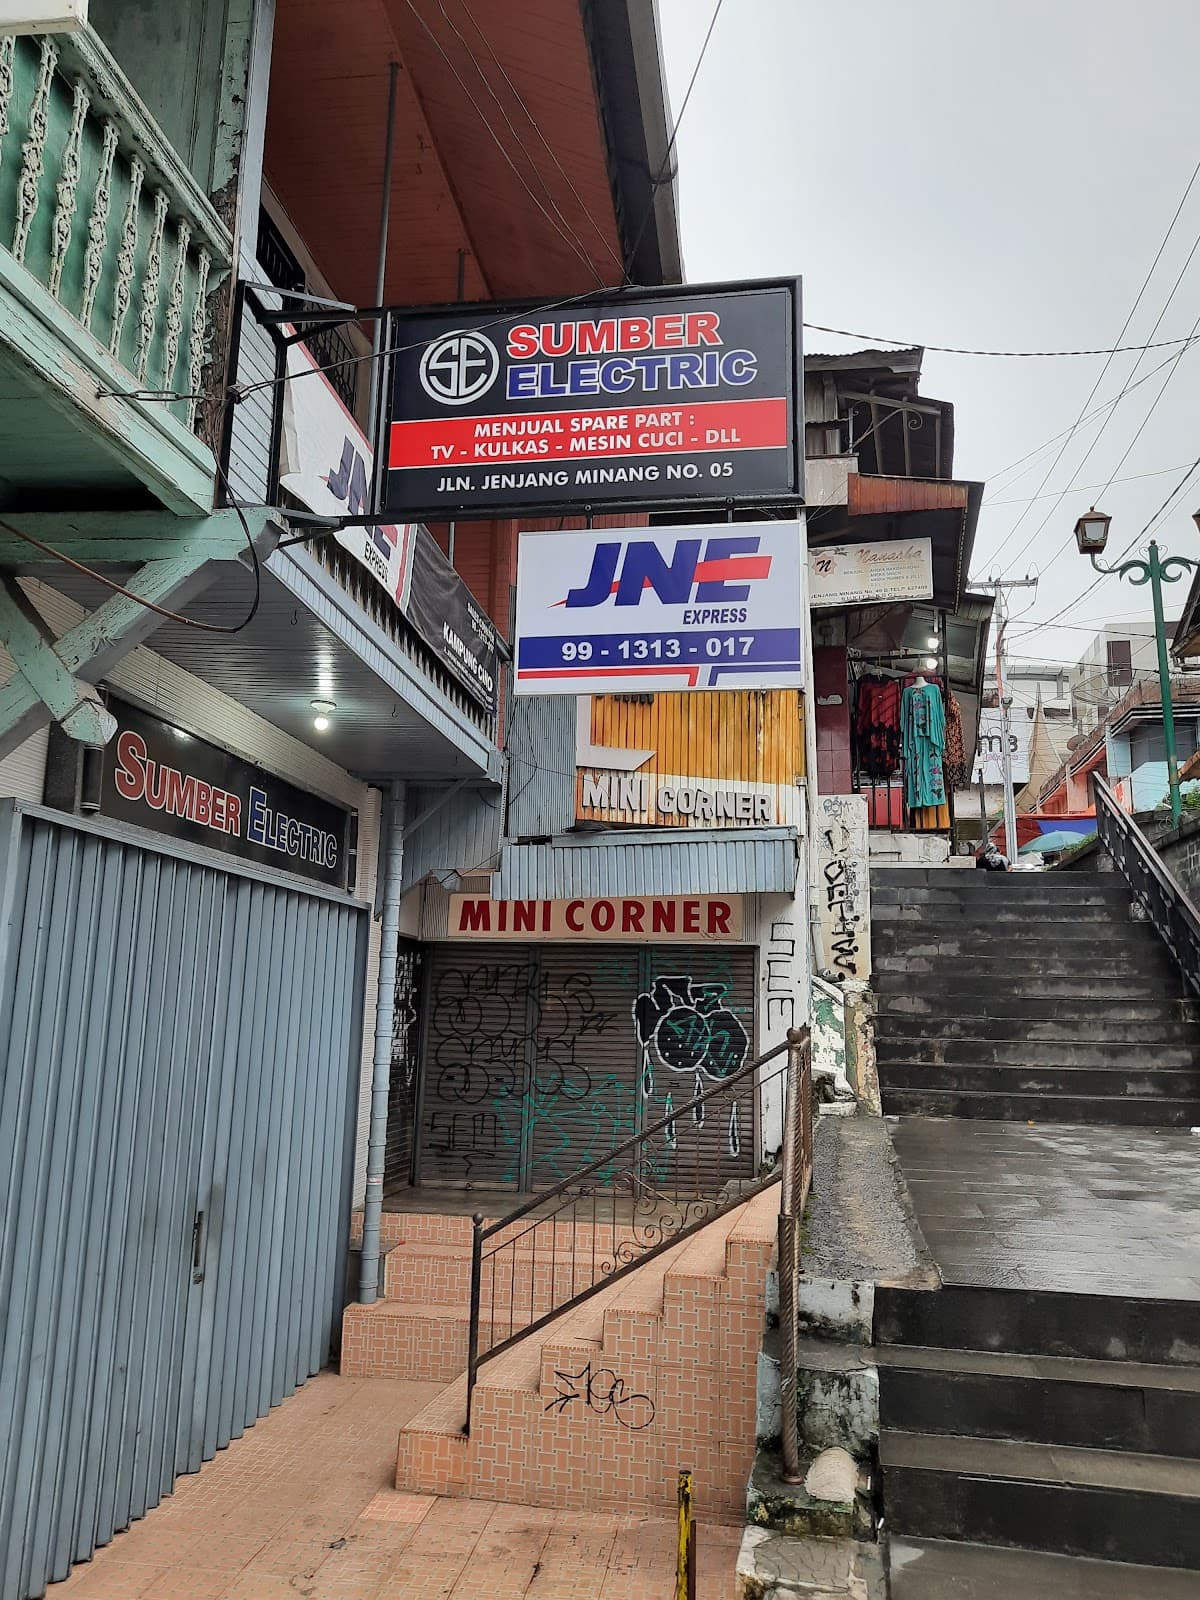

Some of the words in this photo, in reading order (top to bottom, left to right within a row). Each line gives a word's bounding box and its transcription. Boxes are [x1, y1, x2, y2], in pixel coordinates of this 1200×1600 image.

[506, 311, 724, 359] SUMBER
[505, 349, 758, 400] ELECTRIC
[431, 445, 454, 460] TV
[474, 439, 549, 458] KULKAS
[569, 434, 631, 452] MESIN
[638, 431, 683, 448] CUCI
[705, 428, 741, 444] DLL
[474, 418, 564, 438] MENJUAL
[570, 415, 629, 432] SPARE
[635, 411, 683, 428] PART
[437, 476, 476, 492] JLN.
[481, 471, 569, 490] JENJANG
[575, 465, 660, 485] MINANG
[667, 463, 703, 480] NO.
[710, 462, 733, 477] 05
[364, 540, 389, 583] EXPRESS
[548, 536, 773, 609] JNE
[682, 608, 748, 625] EXPRESS
[443, 621, 478, 675] KAMPUNG
[561, 642, 593, 661] 99
[618, 638, 681, 659] 1313
[705, 636, 755, 657] 017
[114, 731, 241, 837] SUMBER
[247, 786, 338, 868] ELECTRIC
[581, 774, 649, 812] MINI
[657, 786, 772, 822] CORNER
[459, 900, 551, 931] MINI
[565, 900, 731, 934] CORNER
